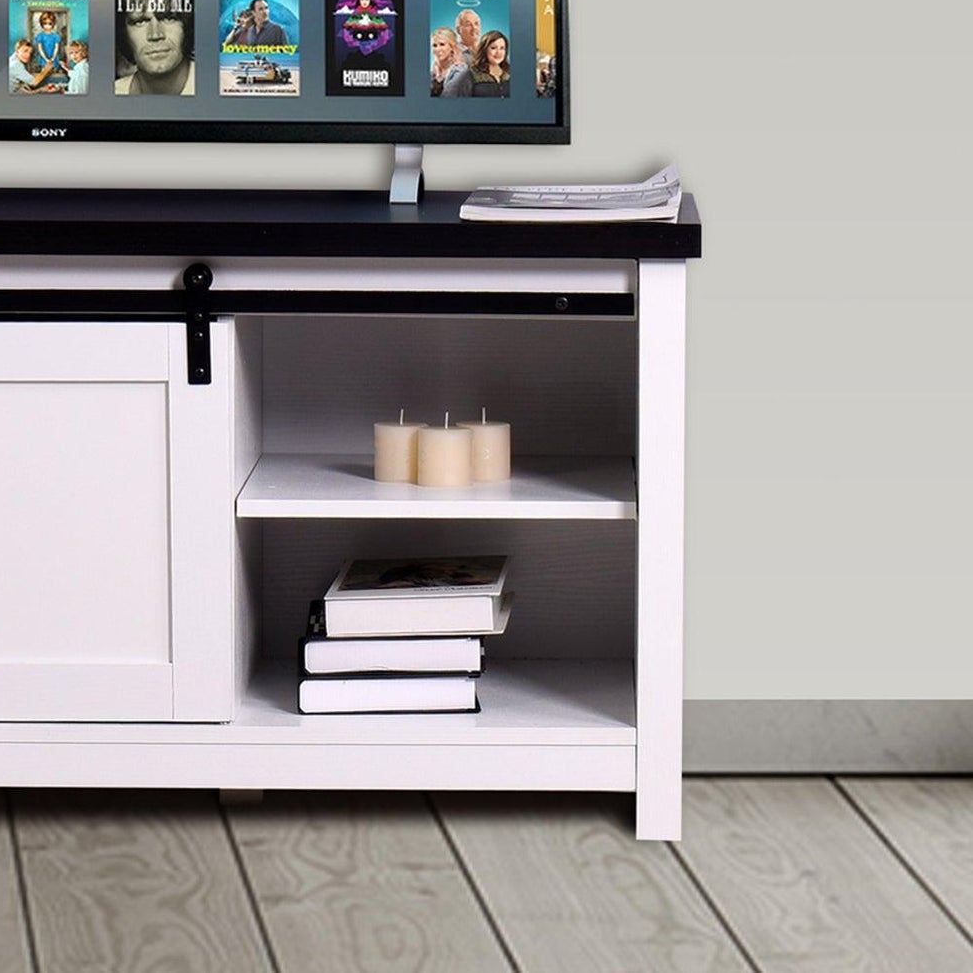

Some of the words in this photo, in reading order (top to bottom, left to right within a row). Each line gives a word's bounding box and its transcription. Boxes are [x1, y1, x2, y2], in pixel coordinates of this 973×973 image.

[222, 41, 249, 54] love
[258, 42, 298, 56] mercy
[342, 69, 389, 83] KUMIKO
[31, 127, 67, 137] SONY
